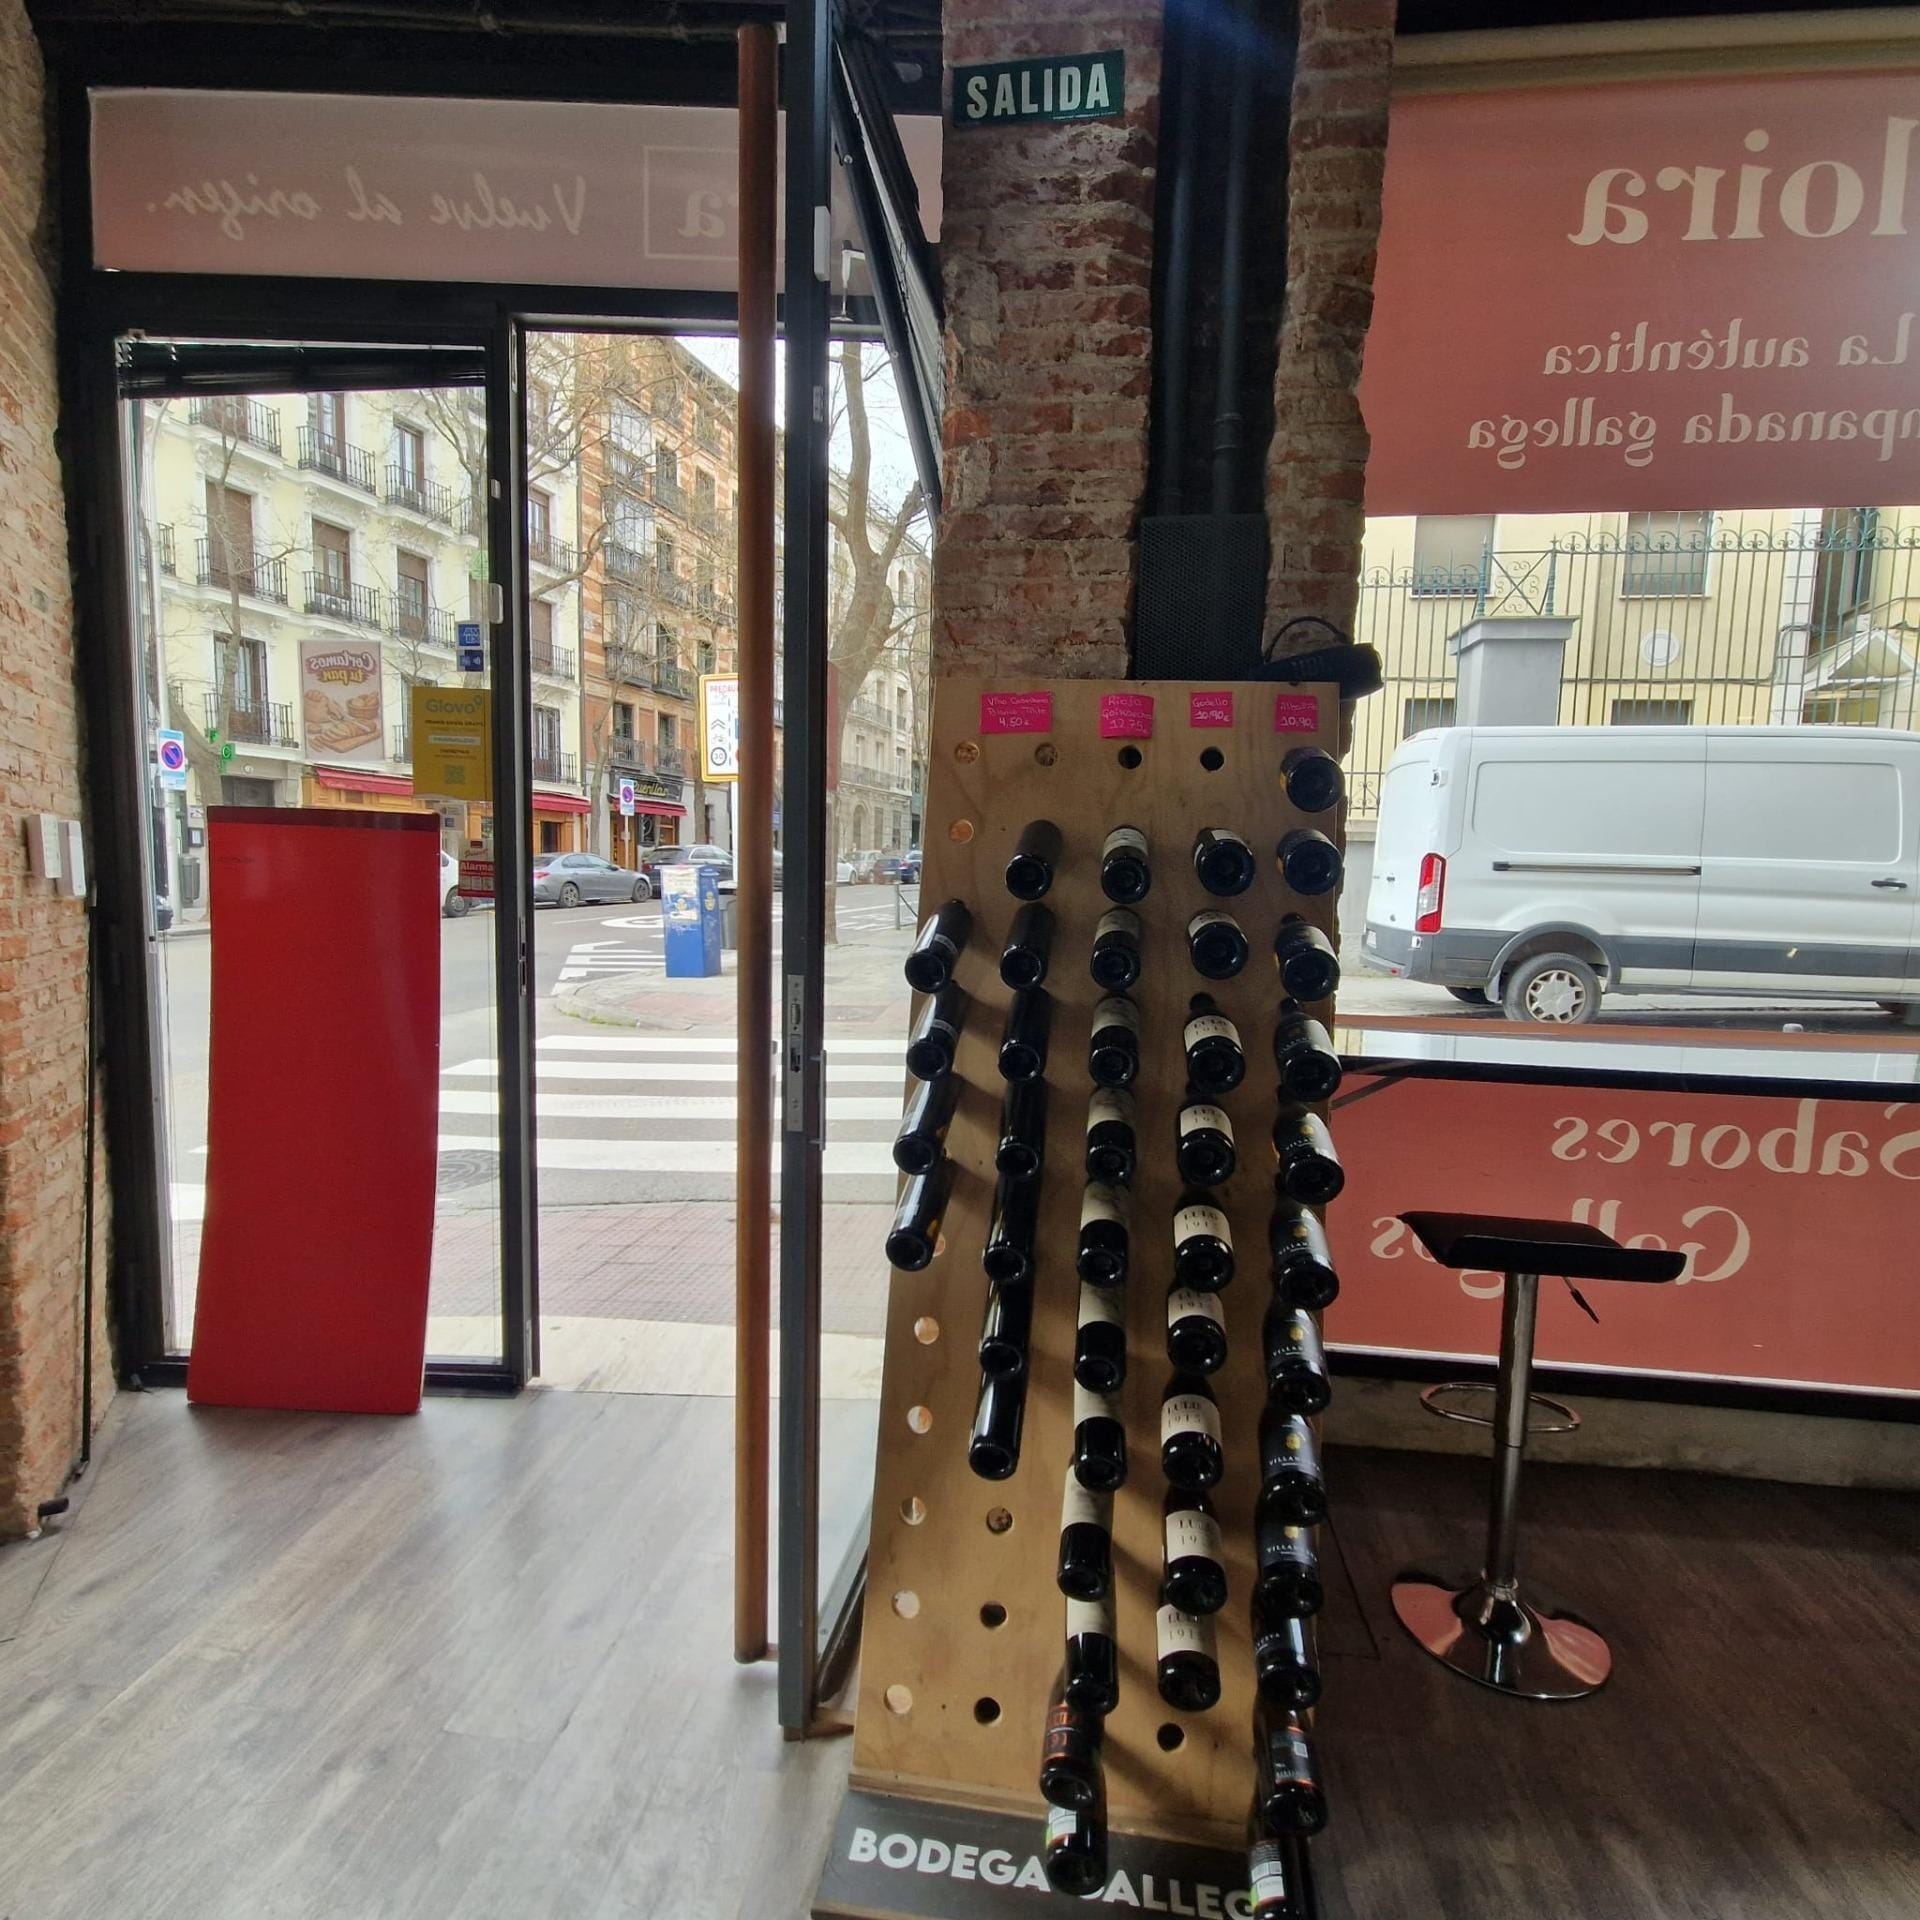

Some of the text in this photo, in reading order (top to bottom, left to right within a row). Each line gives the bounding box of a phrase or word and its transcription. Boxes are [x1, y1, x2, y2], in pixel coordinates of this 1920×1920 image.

[966, 62, 1110, 118] SALIDA
[426, 699, 475, 714] Glovo
[461, 861, 493, 872] Alarma
[848, 1827, 1051, 1892] BODEGA
